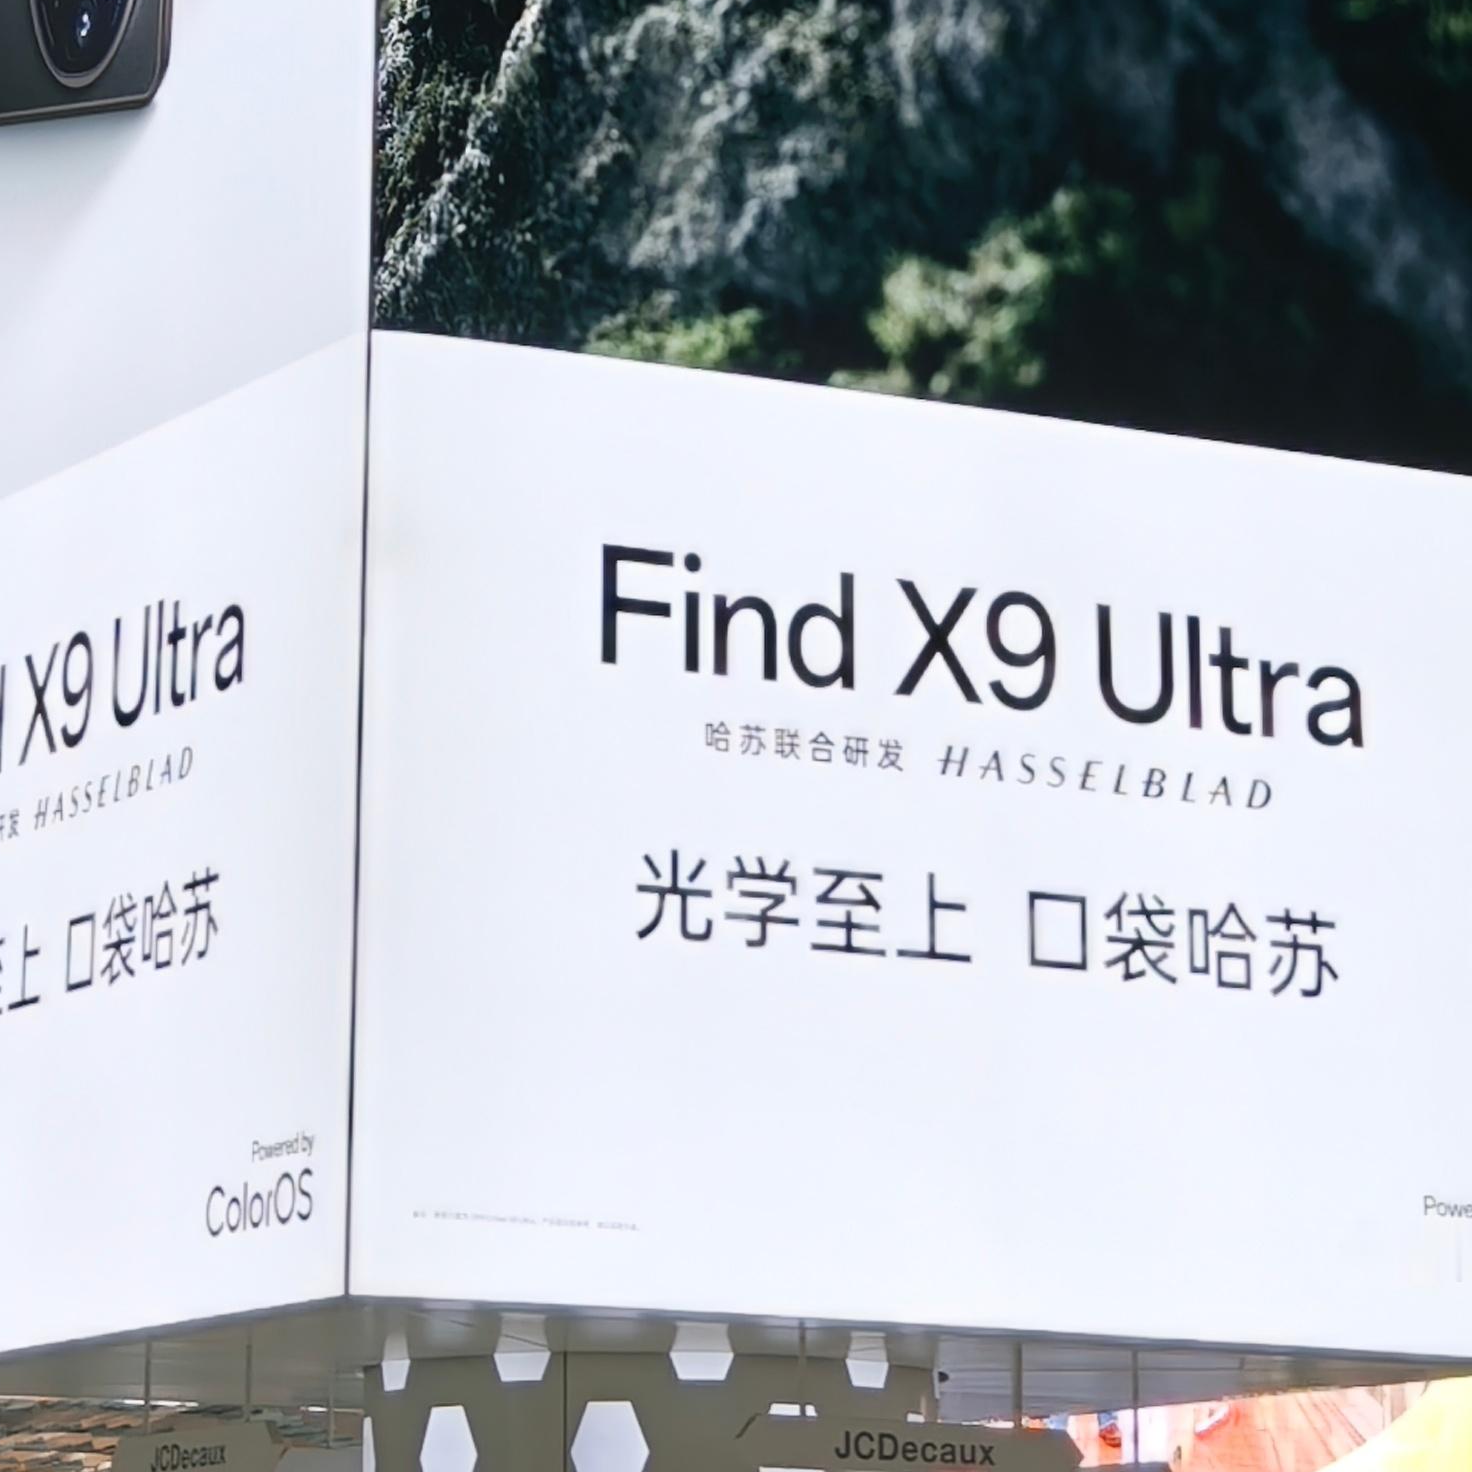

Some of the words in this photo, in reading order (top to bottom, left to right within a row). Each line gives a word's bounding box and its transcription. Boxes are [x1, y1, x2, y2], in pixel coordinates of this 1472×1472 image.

[18, 630, 94, 766] X9
[112, 599, 246, 729] Ultra
[601, 544, 855, 691] Find
[895, 578, 1058, 712] X9
[1085, 604, 1365, 749] Ultra
[33, 744, 195, 830] HASSELBLAD
[704, 720, 905, 773] 哈苏联合研发
[937, 744, 1275, 810] HASSELBLAD
[65, 867, 221, 994] 口袋哈苏
[635, 849, 973, 965] 光学至上
[1027, 890, 1341, 999] 口袋哈苏
[250, 1134, 299, 1164] Powered
[300, 1129, 315, 1159] by
[205, 1167, 314, 1239] ColorOS
[832, 1429, 997, 1468] JCDecaux
